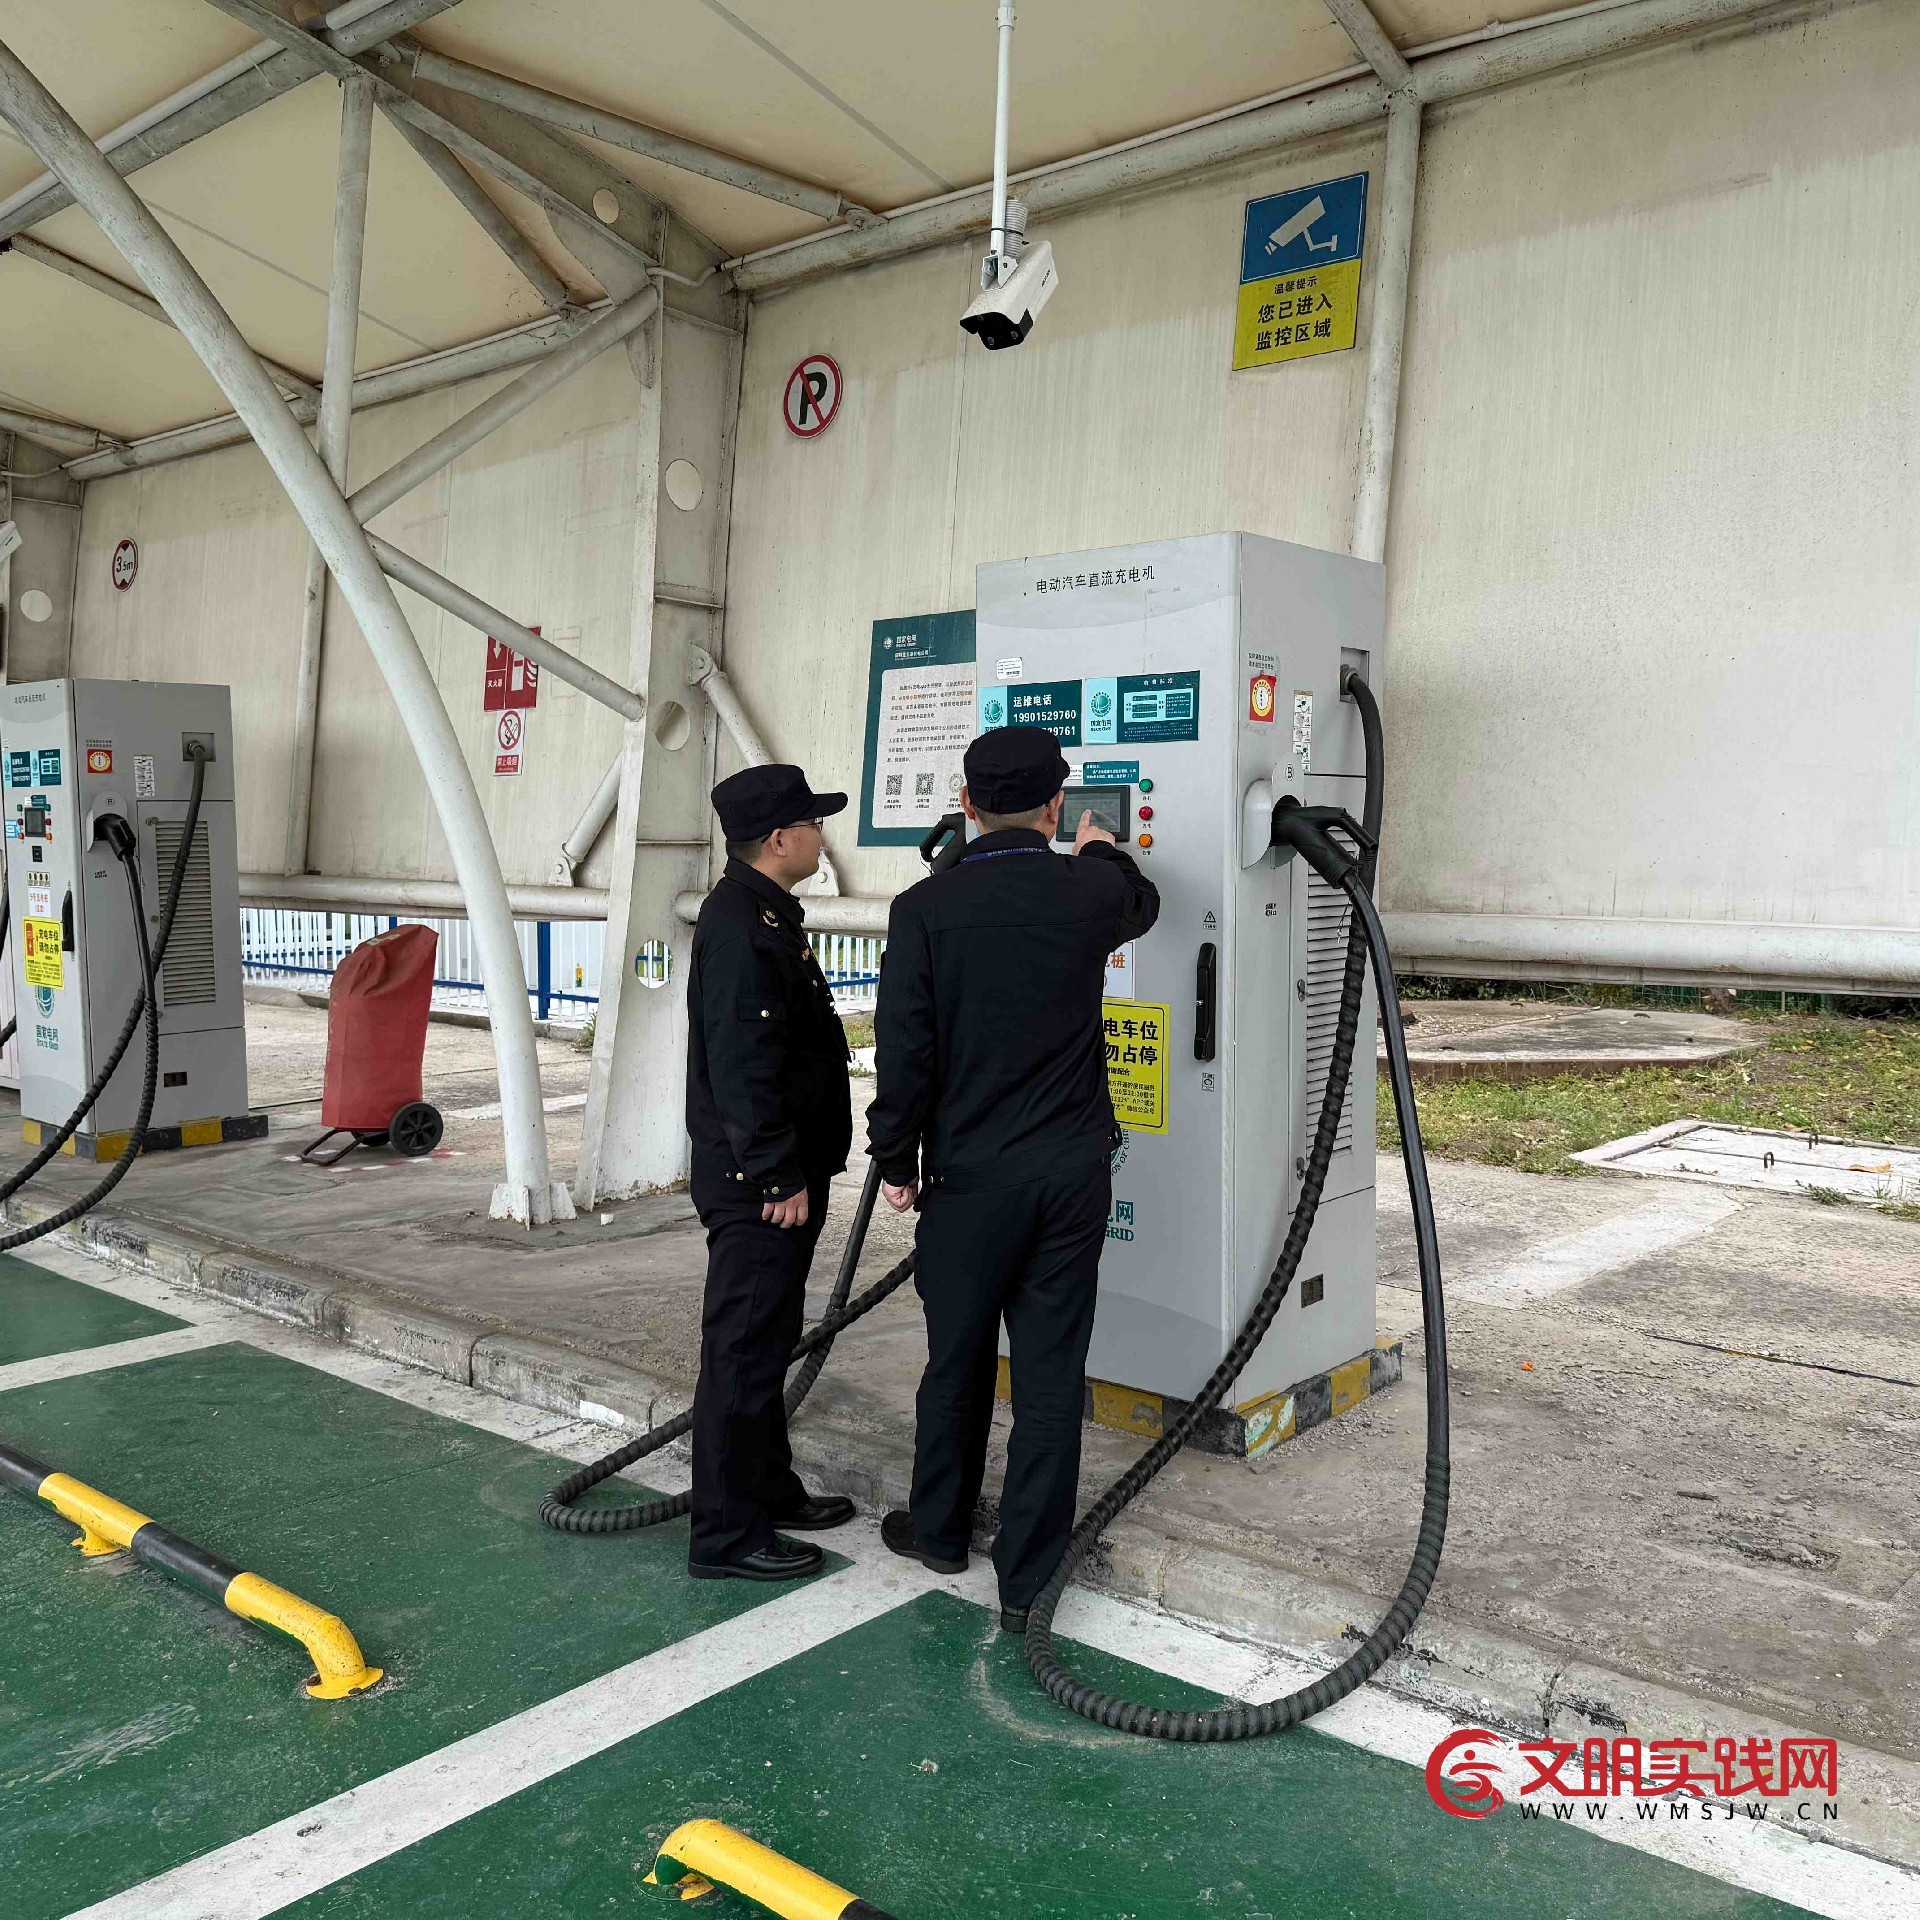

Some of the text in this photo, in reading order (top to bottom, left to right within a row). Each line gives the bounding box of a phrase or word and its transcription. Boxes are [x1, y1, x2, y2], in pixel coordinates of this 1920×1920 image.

[1274, 276, 1318, 295] 温馨提示
[1258, 293, 1333, 324] 您已进入
[1255, 318, 1332, 351] 监控区域
[1037, 565, 1155, 594] 电动汽车直流充电机
[1013, 694, 1052, 708] 运维电话
[1013, 709, 1076, 723] 19901529760
[1104, 1017, 1158, 1041] 电车位
[1105, 1042, 1158, 1066] 勿占停
